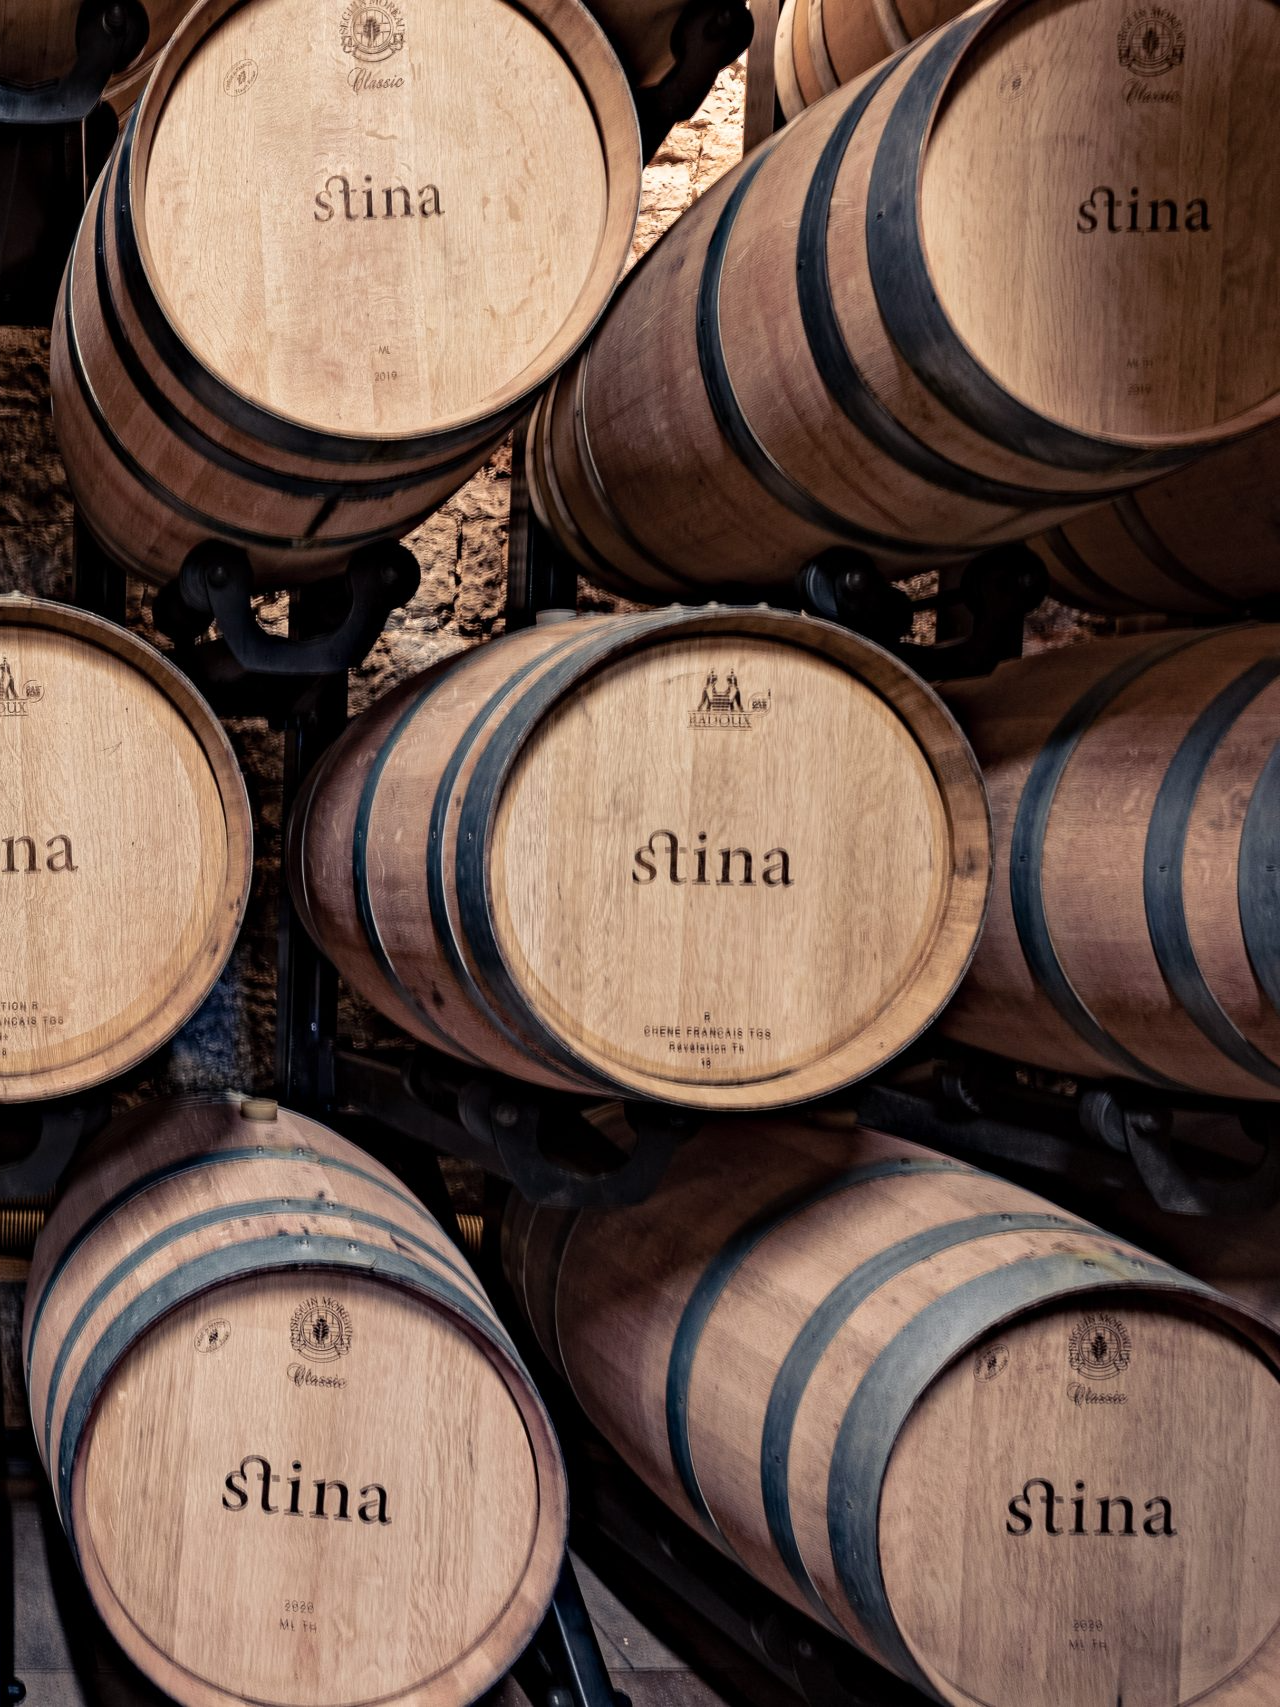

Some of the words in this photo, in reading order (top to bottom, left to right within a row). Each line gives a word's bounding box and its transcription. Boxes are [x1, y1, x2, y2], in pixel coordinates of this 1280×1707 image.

[347, 67, 404, 95] Classic
[314, 174, 445, 221] stina
[1077, 186, 1211, 234] stina
[689, 713, 752, 728] RADOUX
[632, 828, 794, 888] stina
[643, 1025, 681, 1038] CHENE
[287, 1363, 347, 1389] Classic
[1067, 1382, 1128, 1409] Classic
[222, 1454, 392, 1526] stina
[1006, 1477, 1177, 1537] stina
